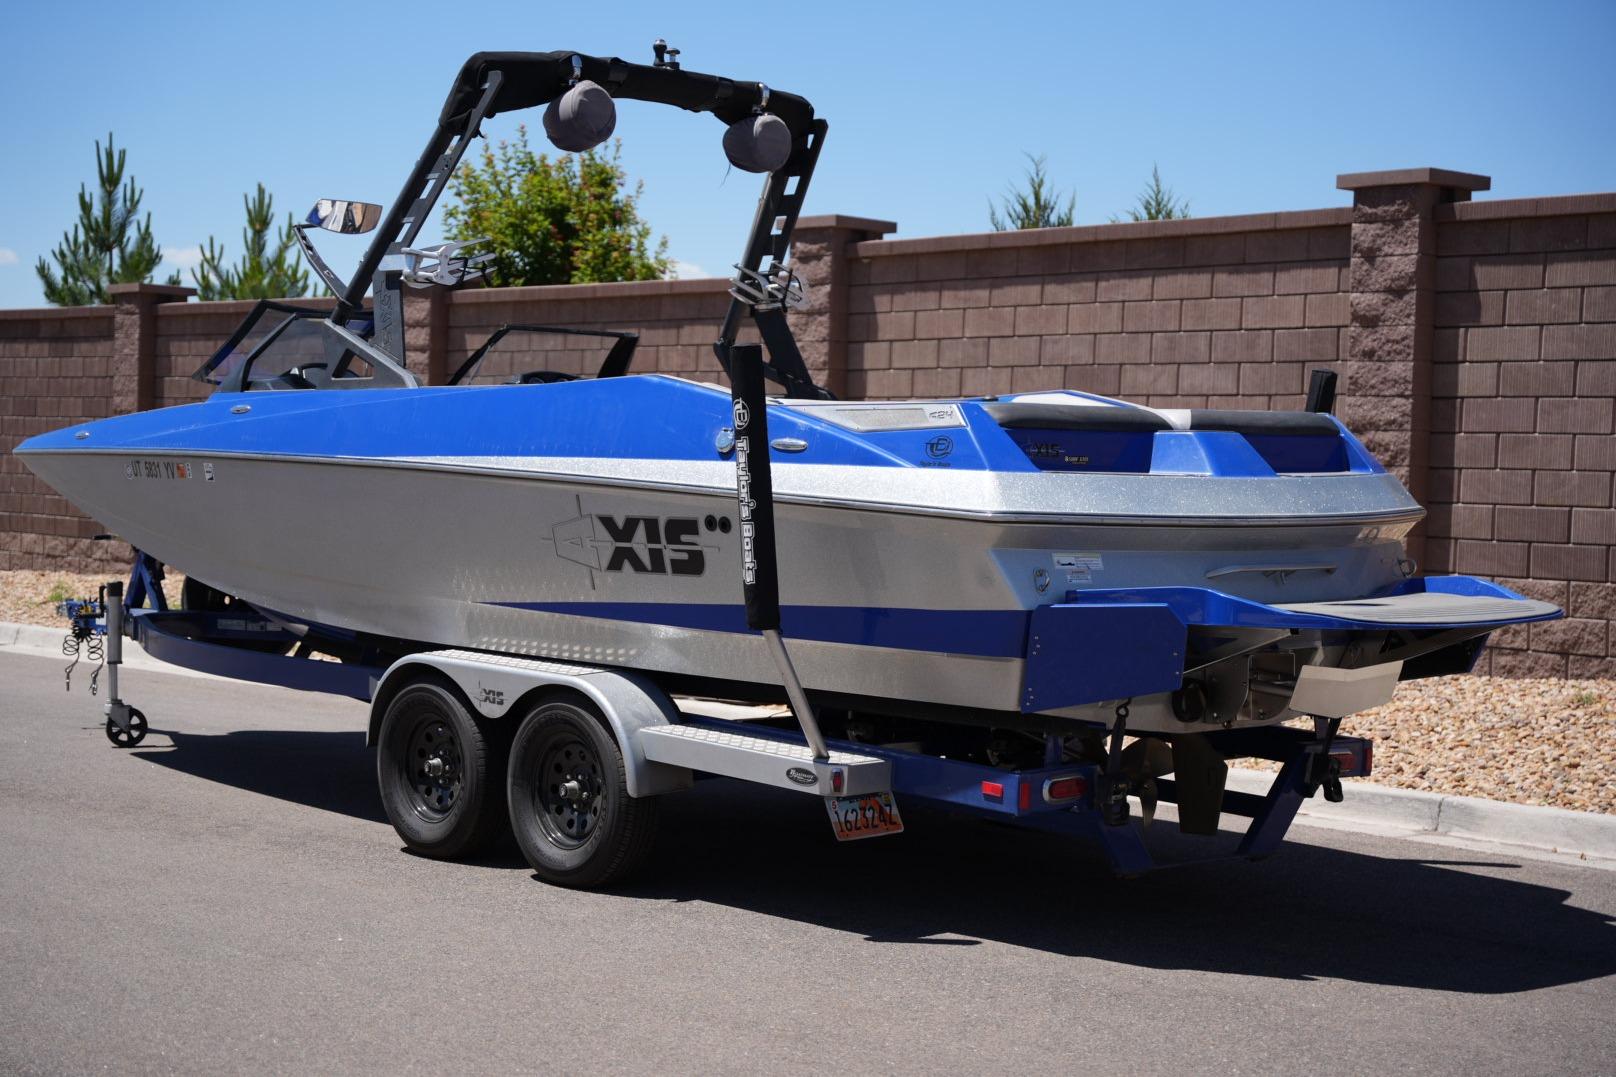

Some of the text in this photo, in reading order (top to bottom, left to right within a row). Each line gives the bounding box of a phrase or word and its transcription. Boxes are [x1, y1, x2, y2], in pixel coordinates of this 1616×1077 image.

[132, 460, 142, 477] UT
[736, 437, 757, 585] Taylor's Boats
